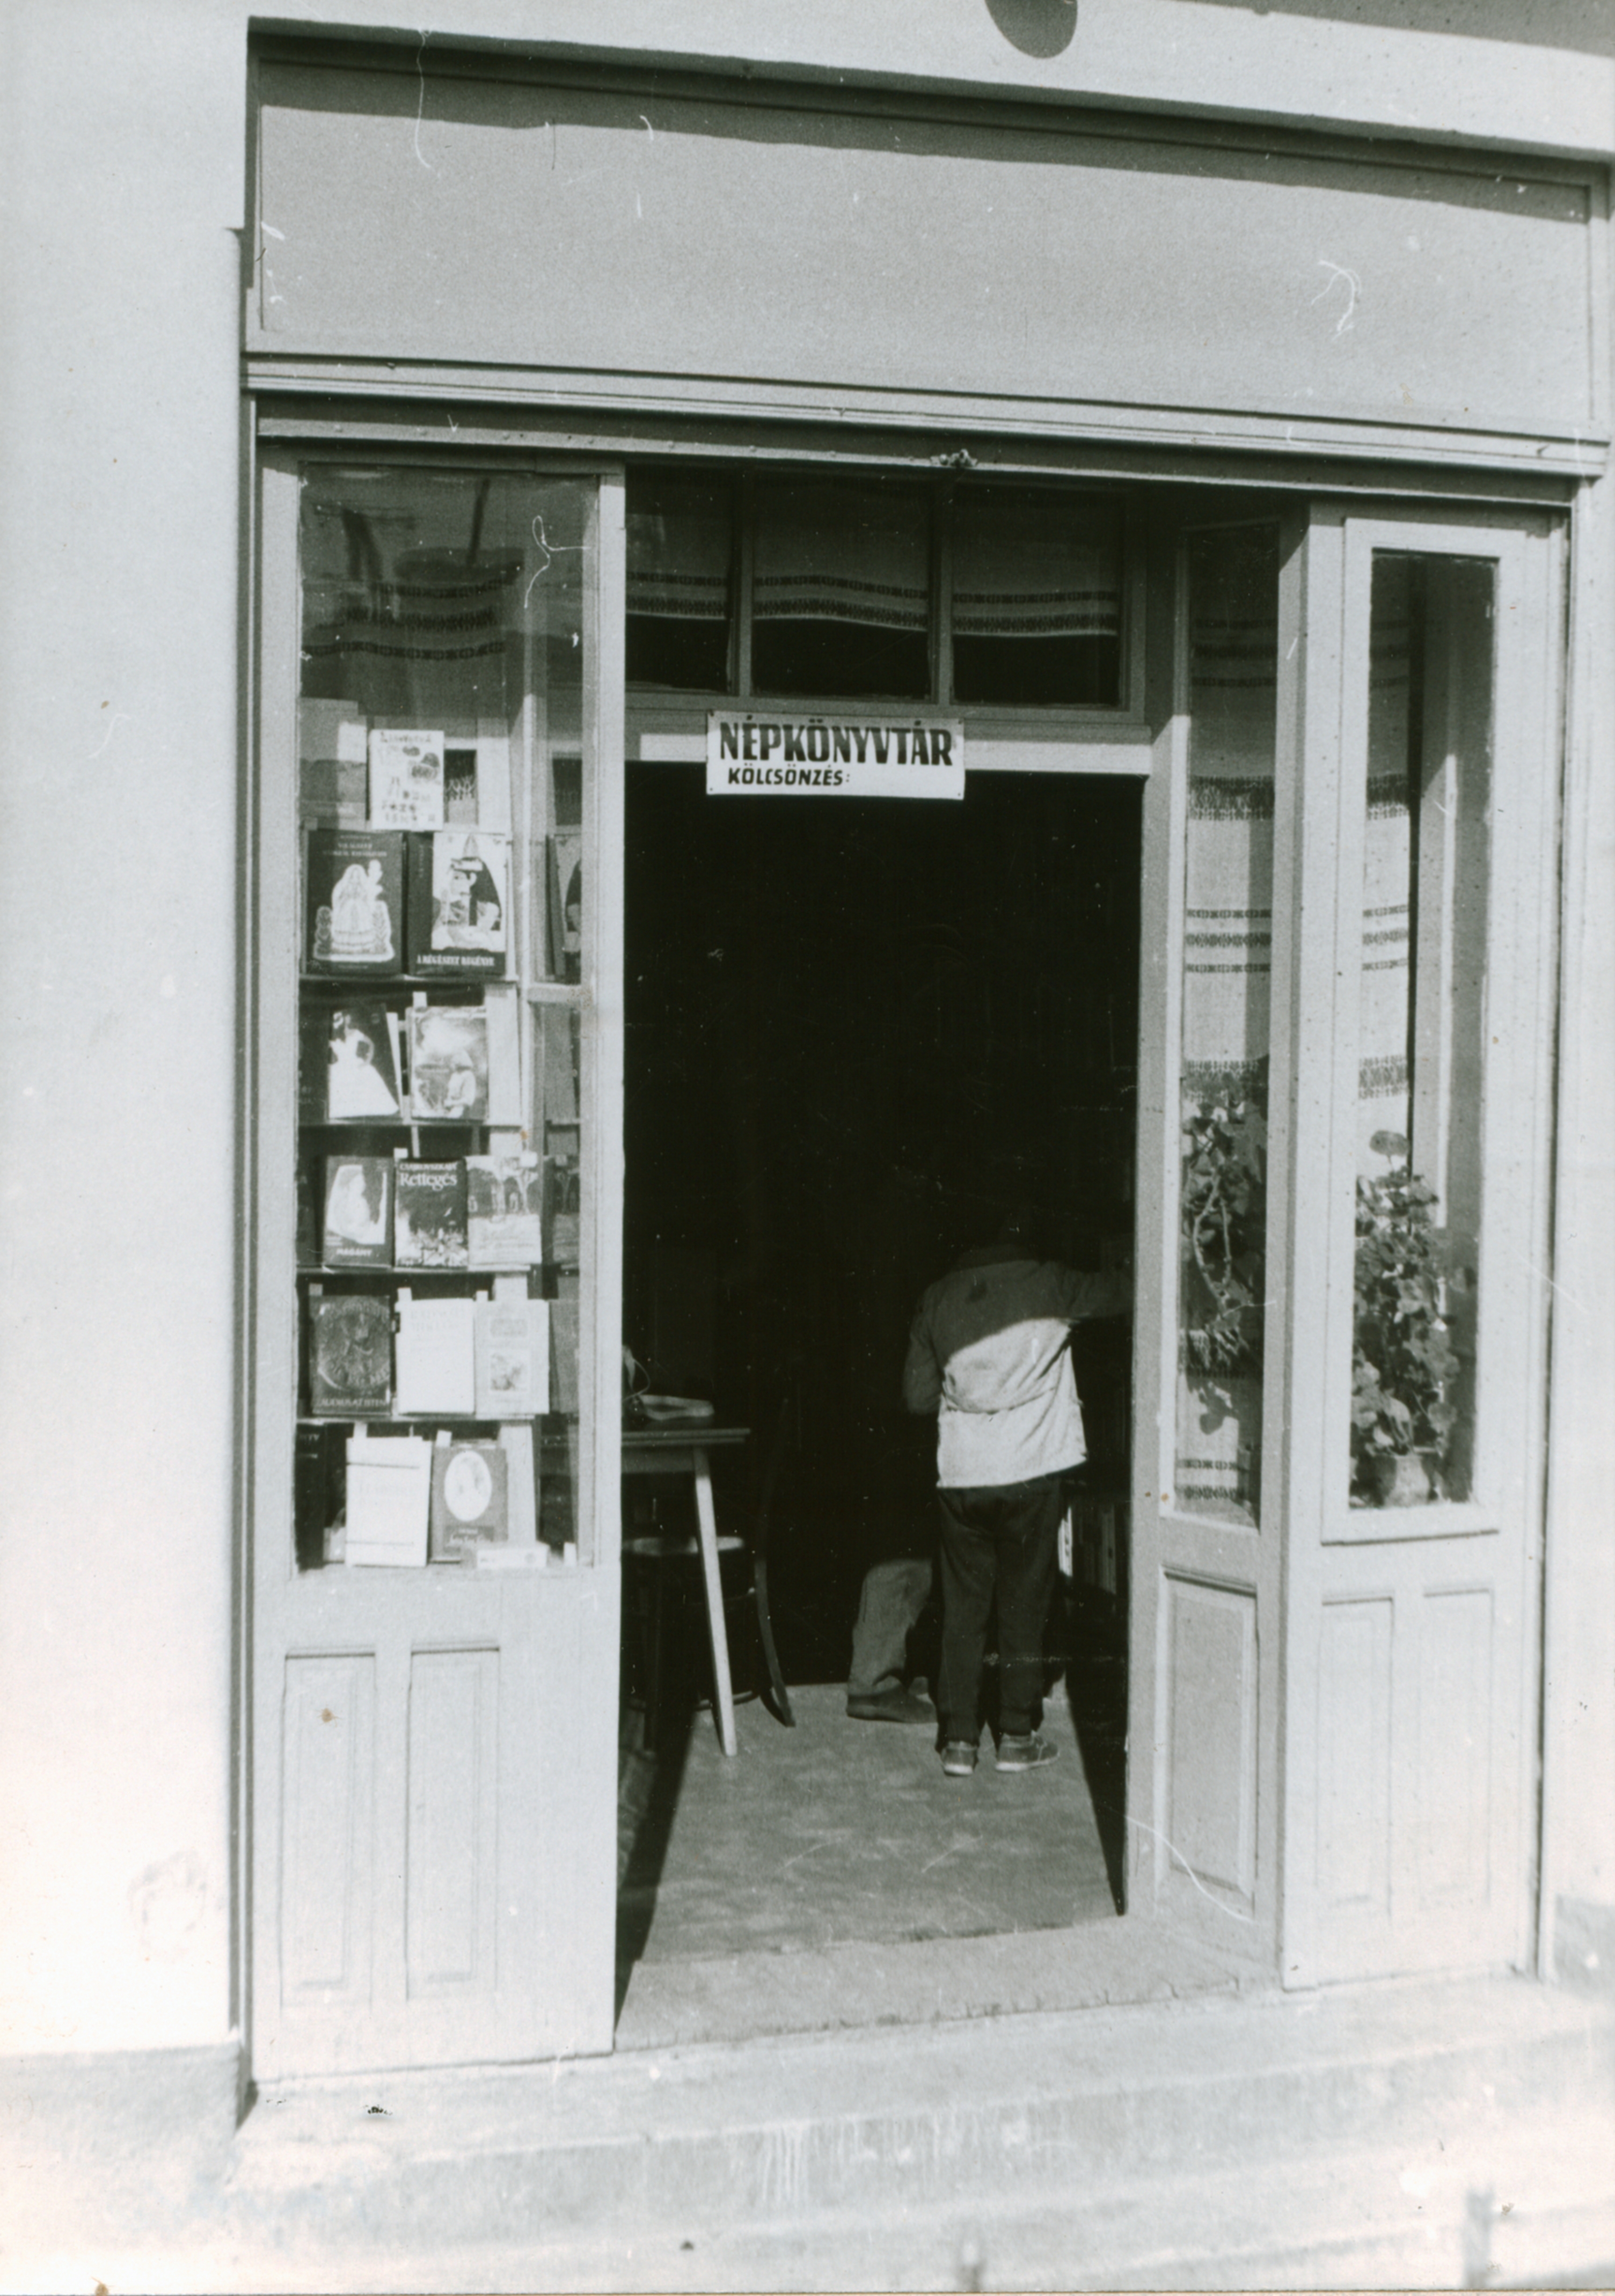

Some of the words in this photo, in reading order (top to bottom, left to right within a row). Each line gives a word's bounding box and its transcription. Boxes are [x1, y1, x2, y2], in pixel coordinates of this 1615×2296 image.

[720, 715, 953, 766] NÉPKÖNYVTÁR
[728, 763, 850, 786] KÖLCSÖNZÉS:
[400, 1172, 457, 1191] Rettegés
